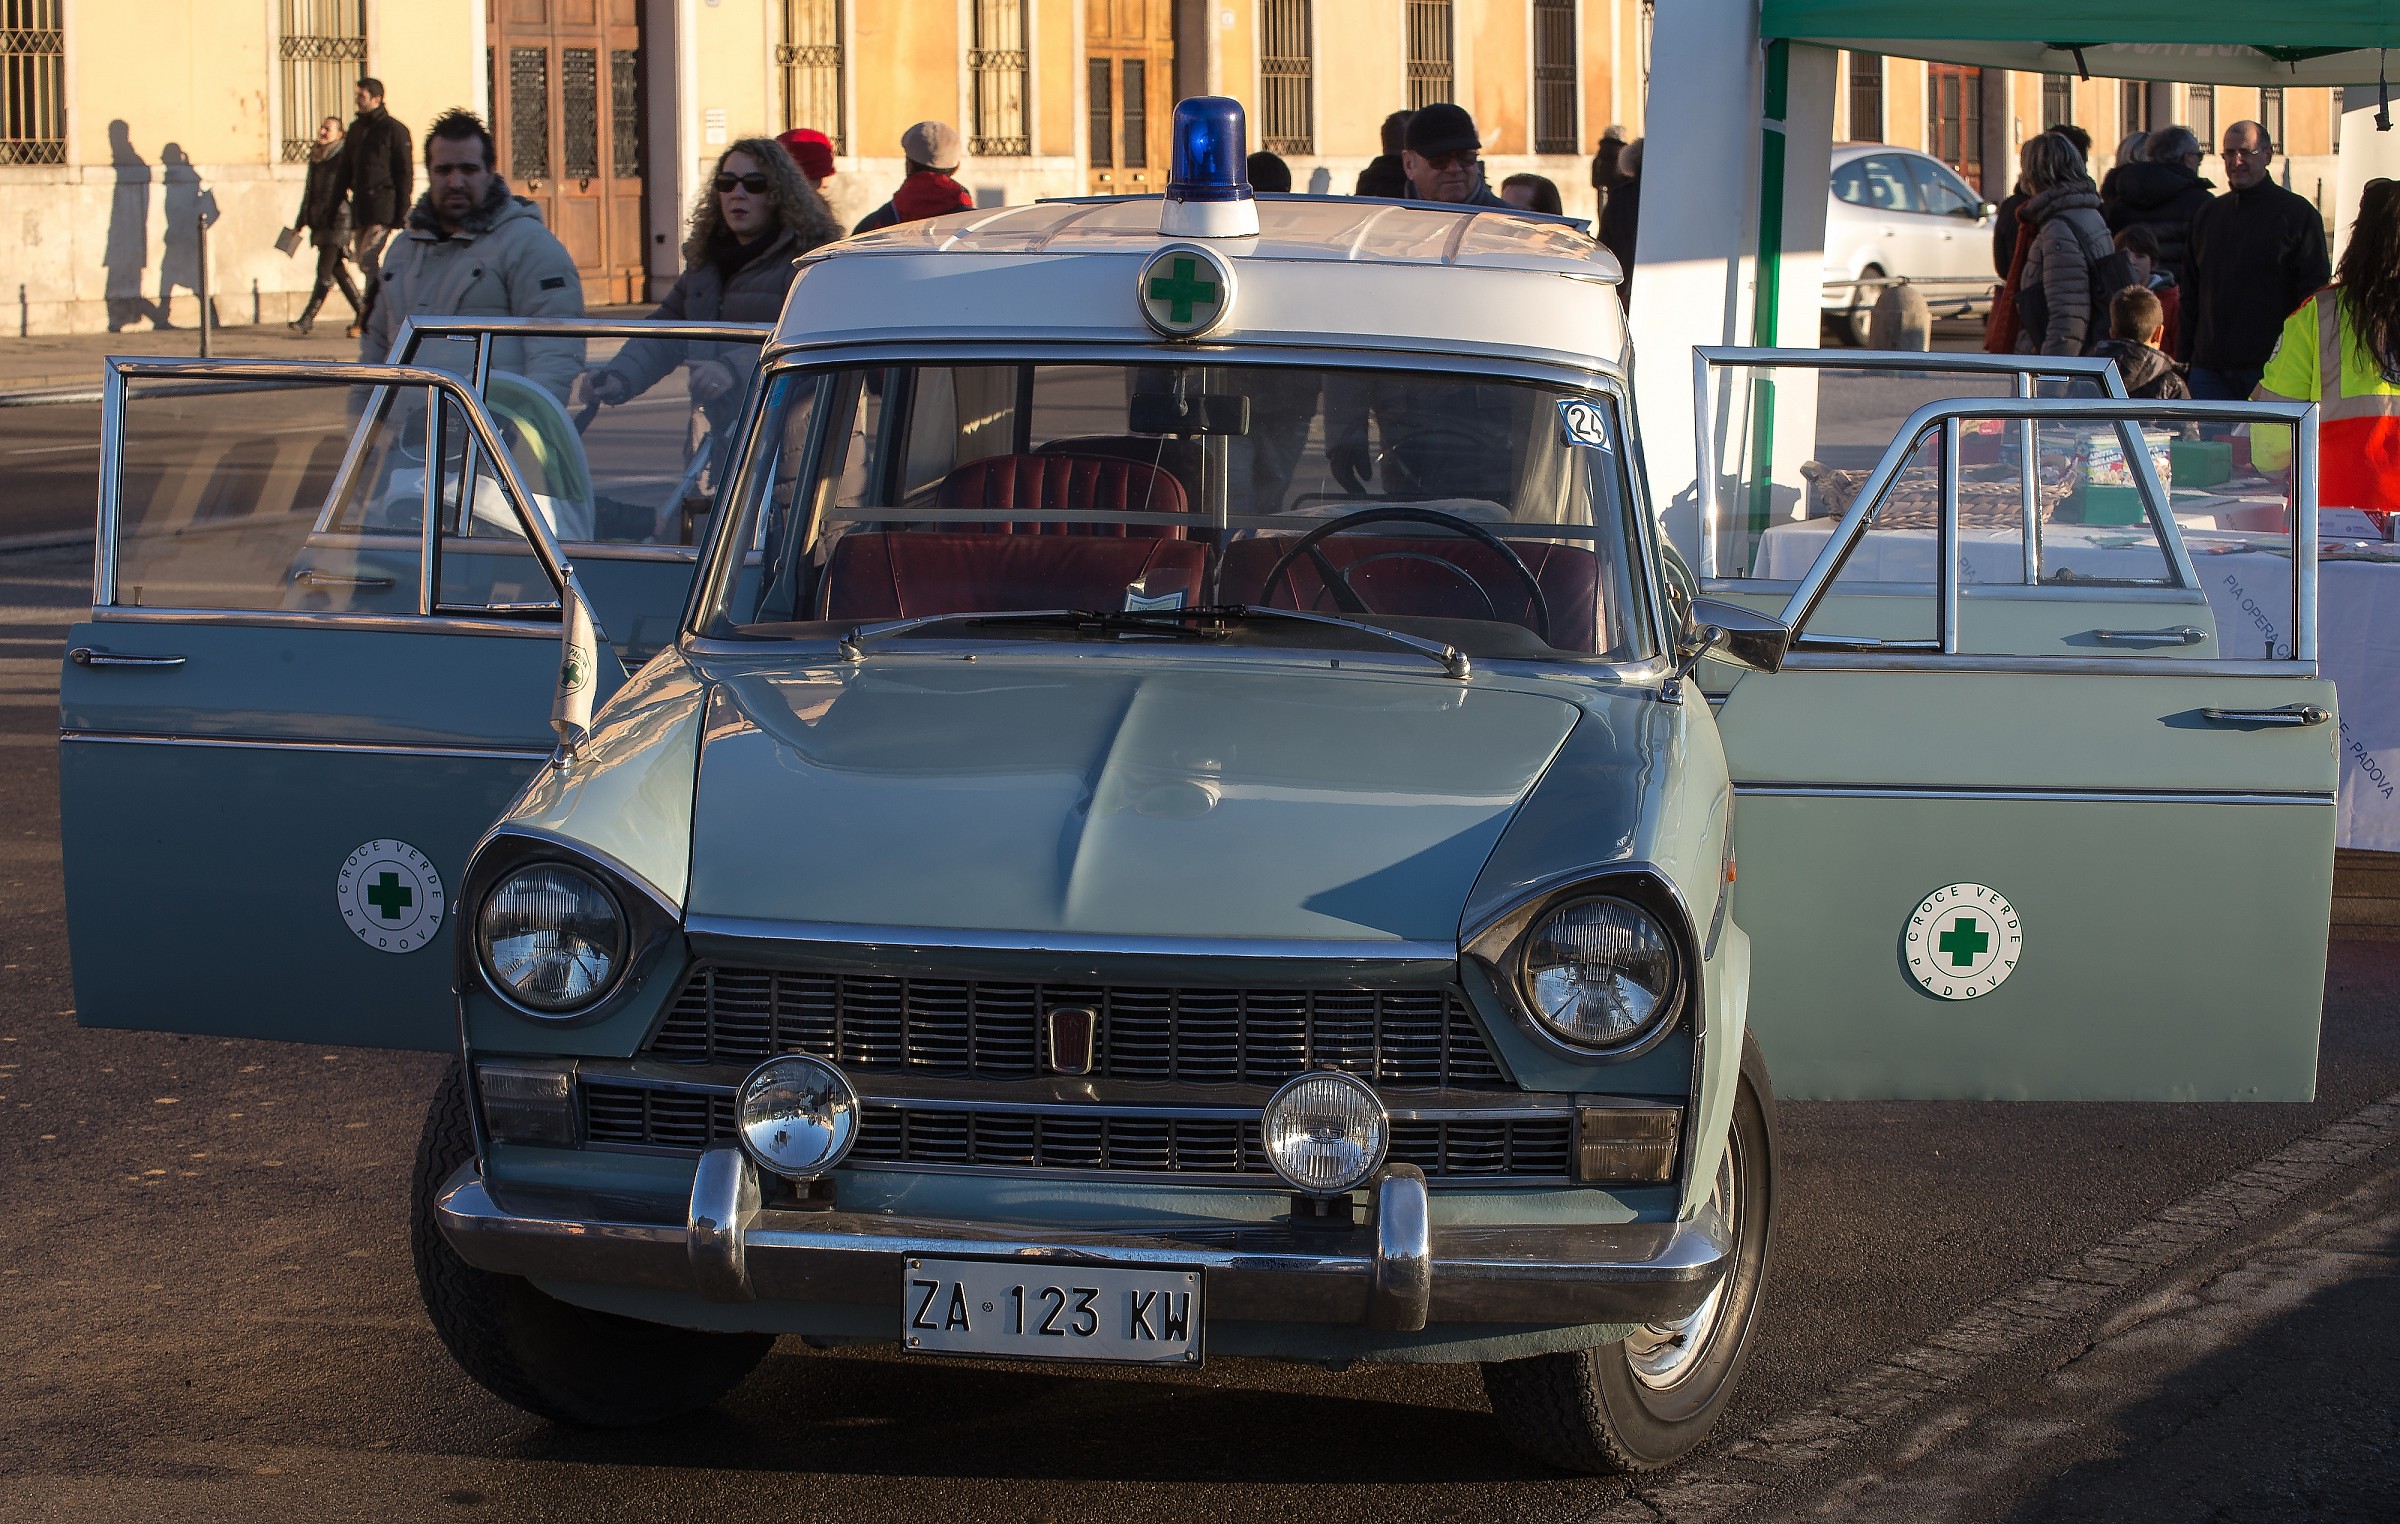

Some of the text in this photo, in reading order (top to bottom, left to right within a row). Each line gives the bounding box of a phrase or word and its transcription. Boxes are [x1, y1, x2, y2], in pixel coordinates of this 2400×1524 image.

[2222, 574, 2244, 602] PIA
[2241, 598, 2279, 643] OPERA
[2349, 741, 2394, 800] PADOVA
[338, 841, 442, 899] CROCE VERDE
[344, 909, 440, 949] PADOVA
[1908, 886, 2021, 943] CROCE VERDE
[1910, 957, 2015, 997] PADOVA
[911, 1278, 1192, 1342] ZA 123 KW
